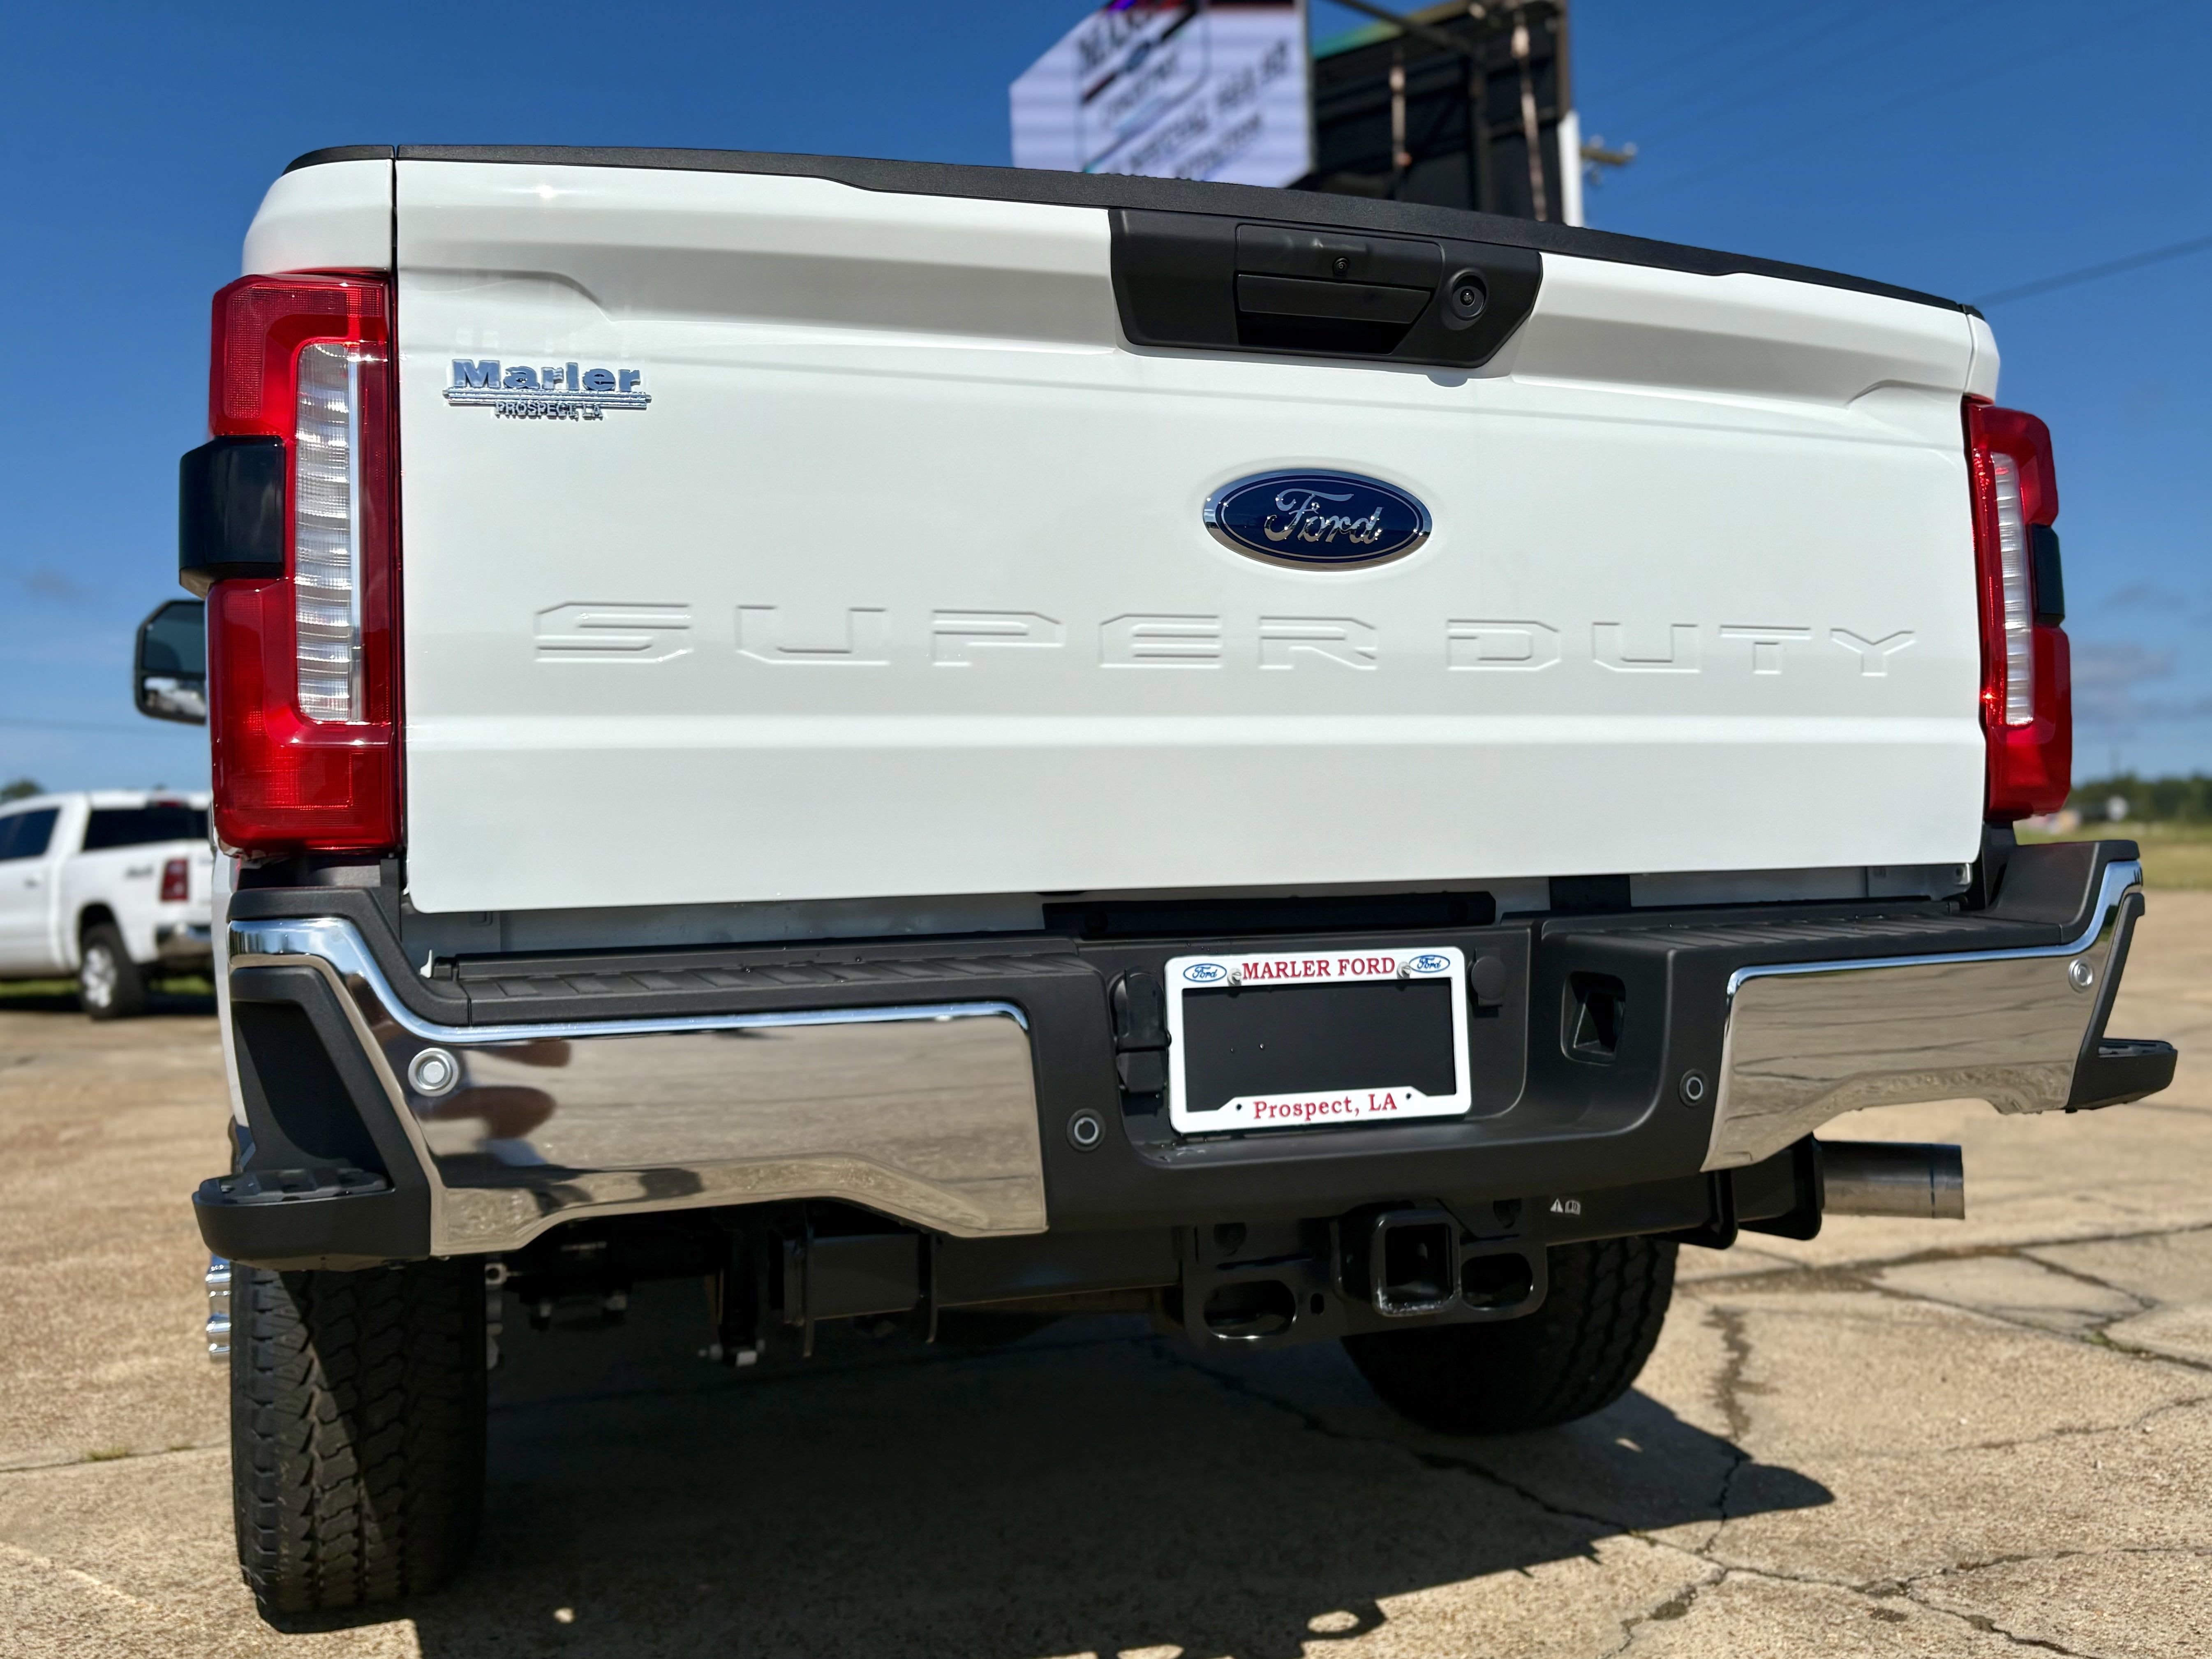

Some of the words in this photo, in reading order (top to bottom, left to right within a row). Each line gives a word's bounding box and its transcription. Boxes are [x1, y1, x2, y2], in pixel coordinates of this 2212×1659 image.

[452, 359, 641, 392] Marler
[582, 403, 603, 421] LA
[1264, 488, 1384, 544] Ford
[534, 602, 1377, 668] SUPER
[1446, 619, 1917, 676] DUTY
[1192, 966, 1218, 979] Ford
[1242, 959, 1331, 980] MARLER
[1338, 957, 1395, 976] FORD
[1417, 957, 1441, 969] Ford
[1253, 1096, 1359, 1122] Prospect,
[1368, 1093, 1398, 1111] LA
